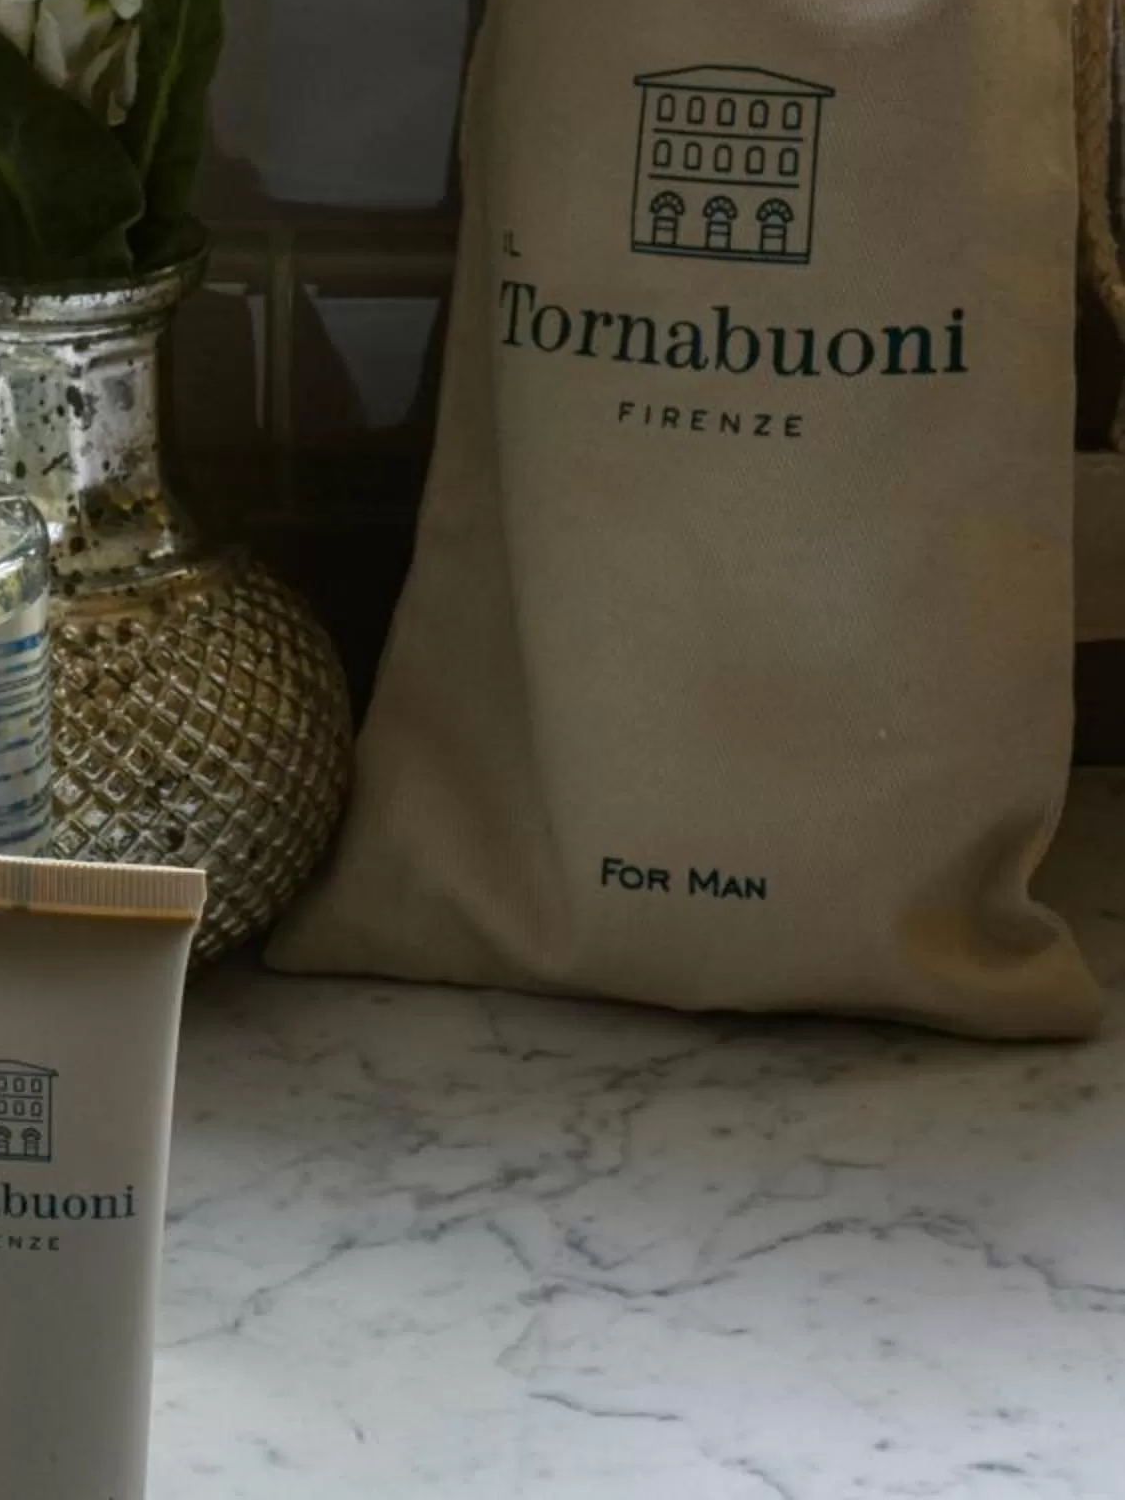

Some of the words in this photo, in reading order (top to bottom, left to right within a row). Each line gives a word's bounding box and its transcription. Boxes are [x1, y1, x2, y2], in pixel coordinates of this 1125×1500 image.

[504, 230, 522, 258] IL
[499, 279, 970, 378] Tornabuoni
[617, 401, 804, 438] FIRENZE
